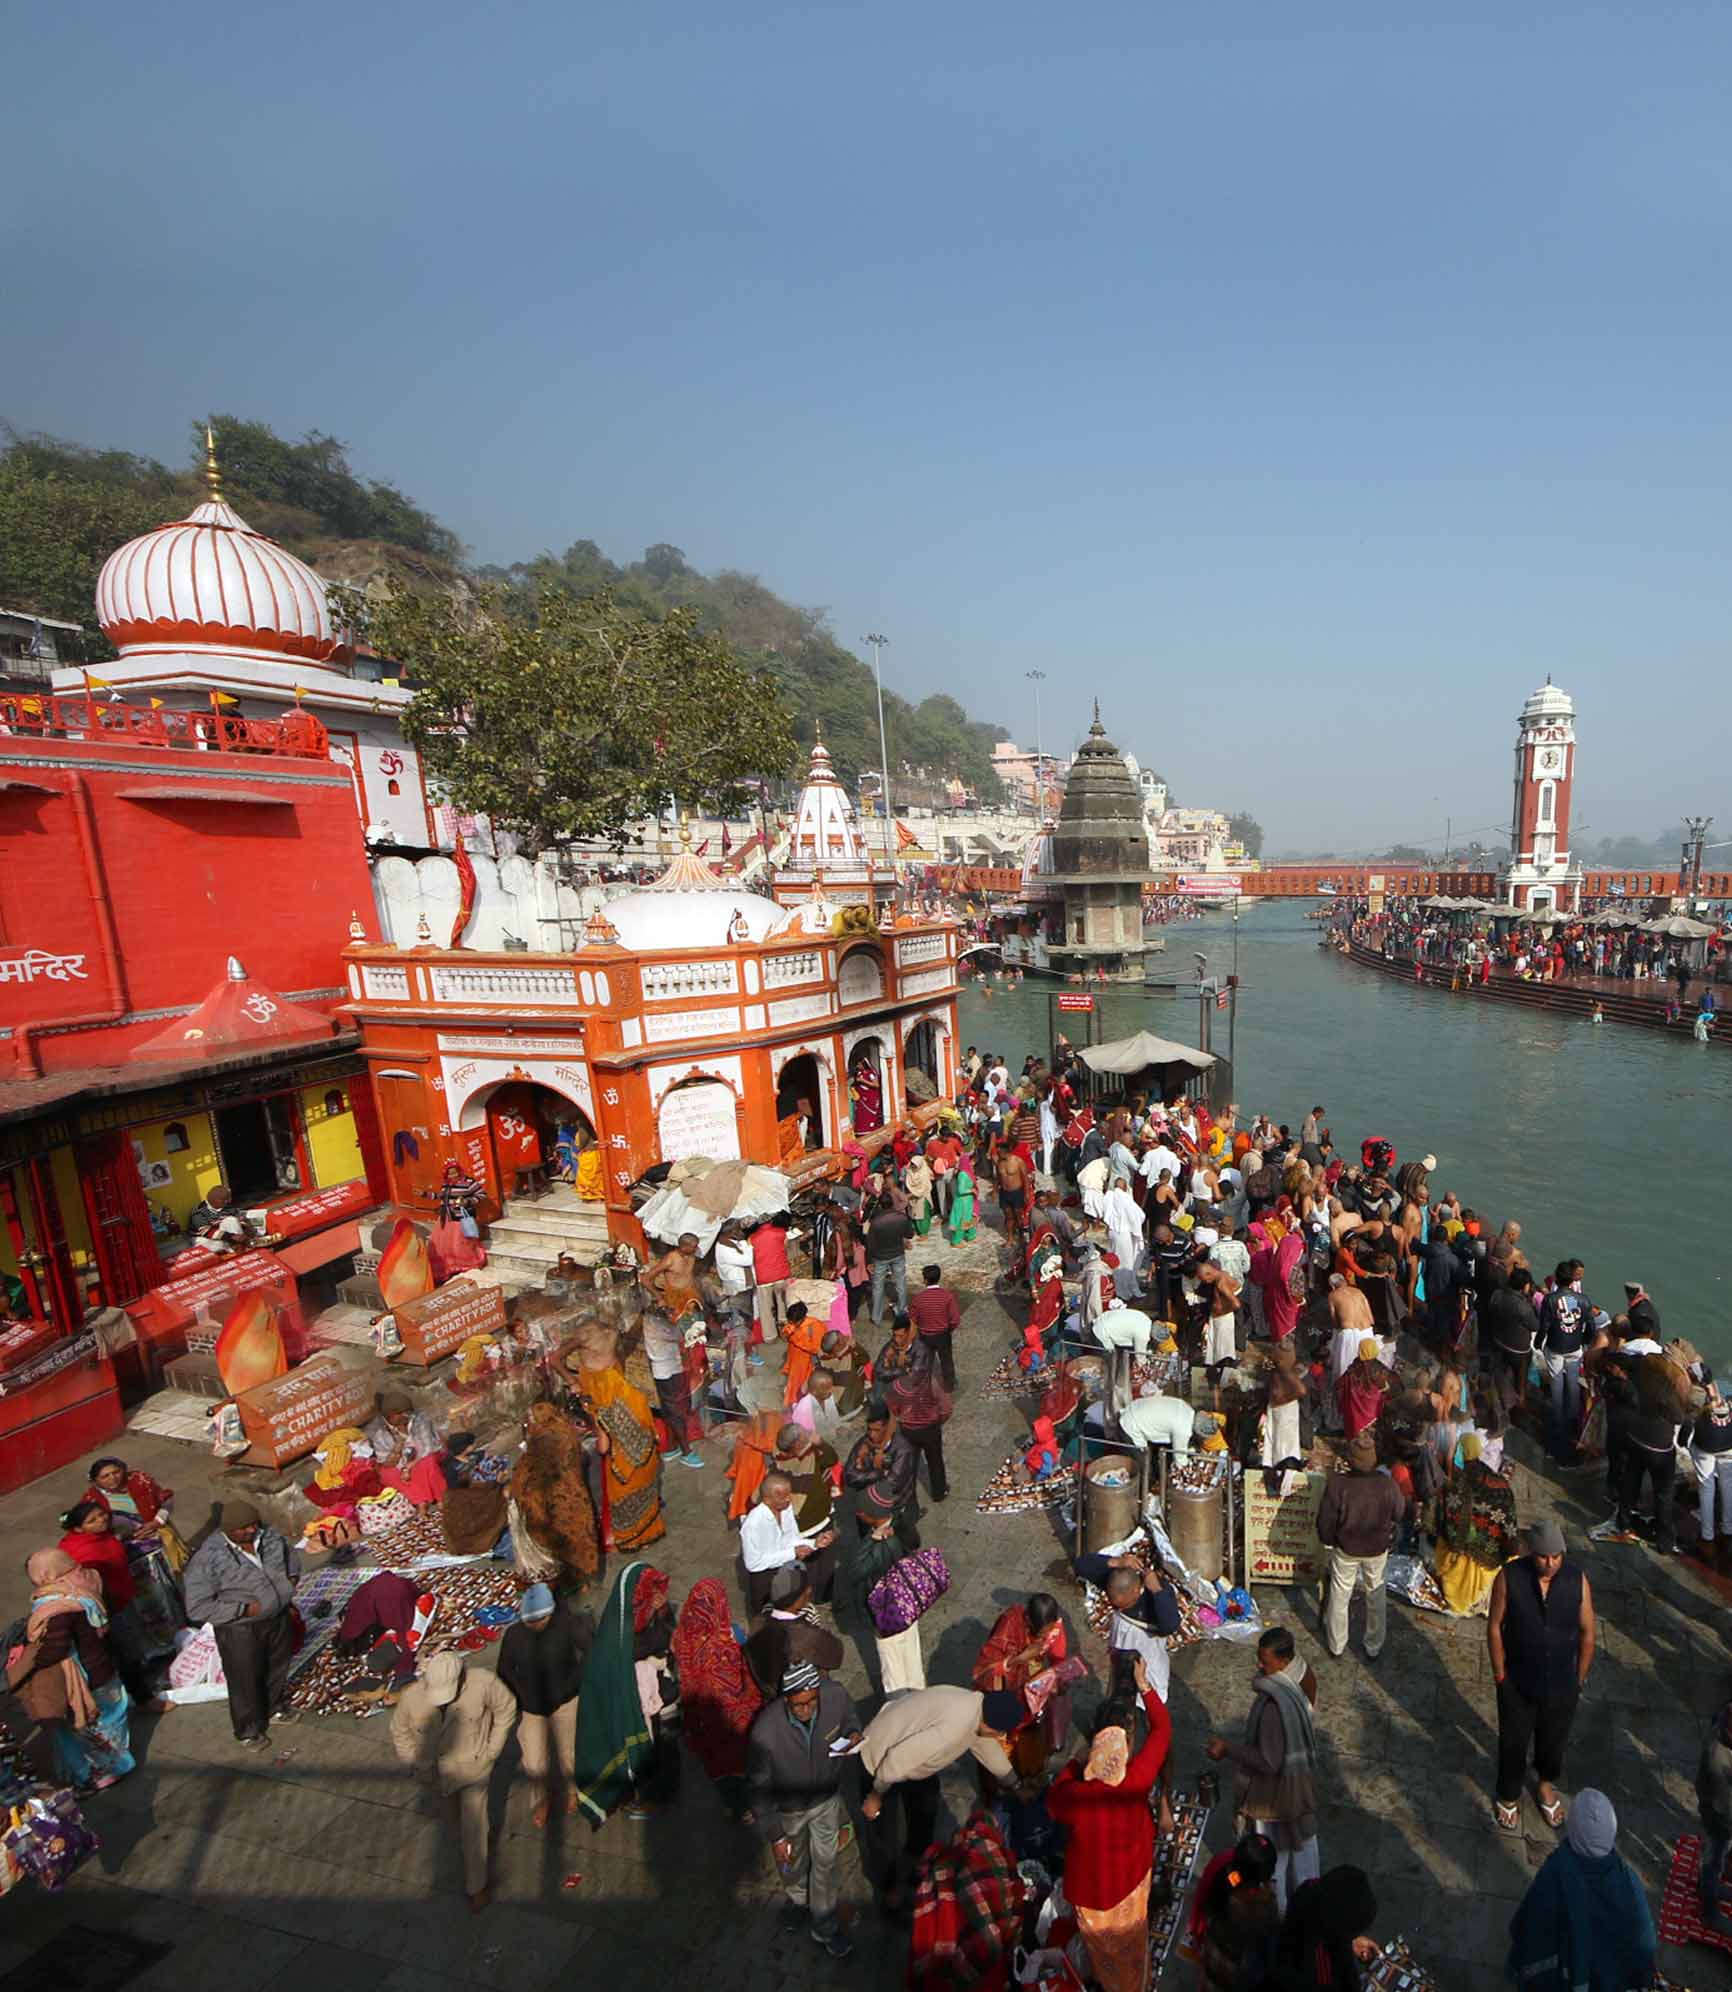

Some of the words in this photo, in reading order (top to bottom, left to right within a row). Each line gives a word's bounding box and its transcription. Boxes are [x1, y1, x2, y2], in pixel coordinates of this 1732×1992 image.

[434, 1307, 480, 1339] CHARITY
[479, 1299, 498, 1318] BOX
[287, 1394, 345, 1434] CHARITY
